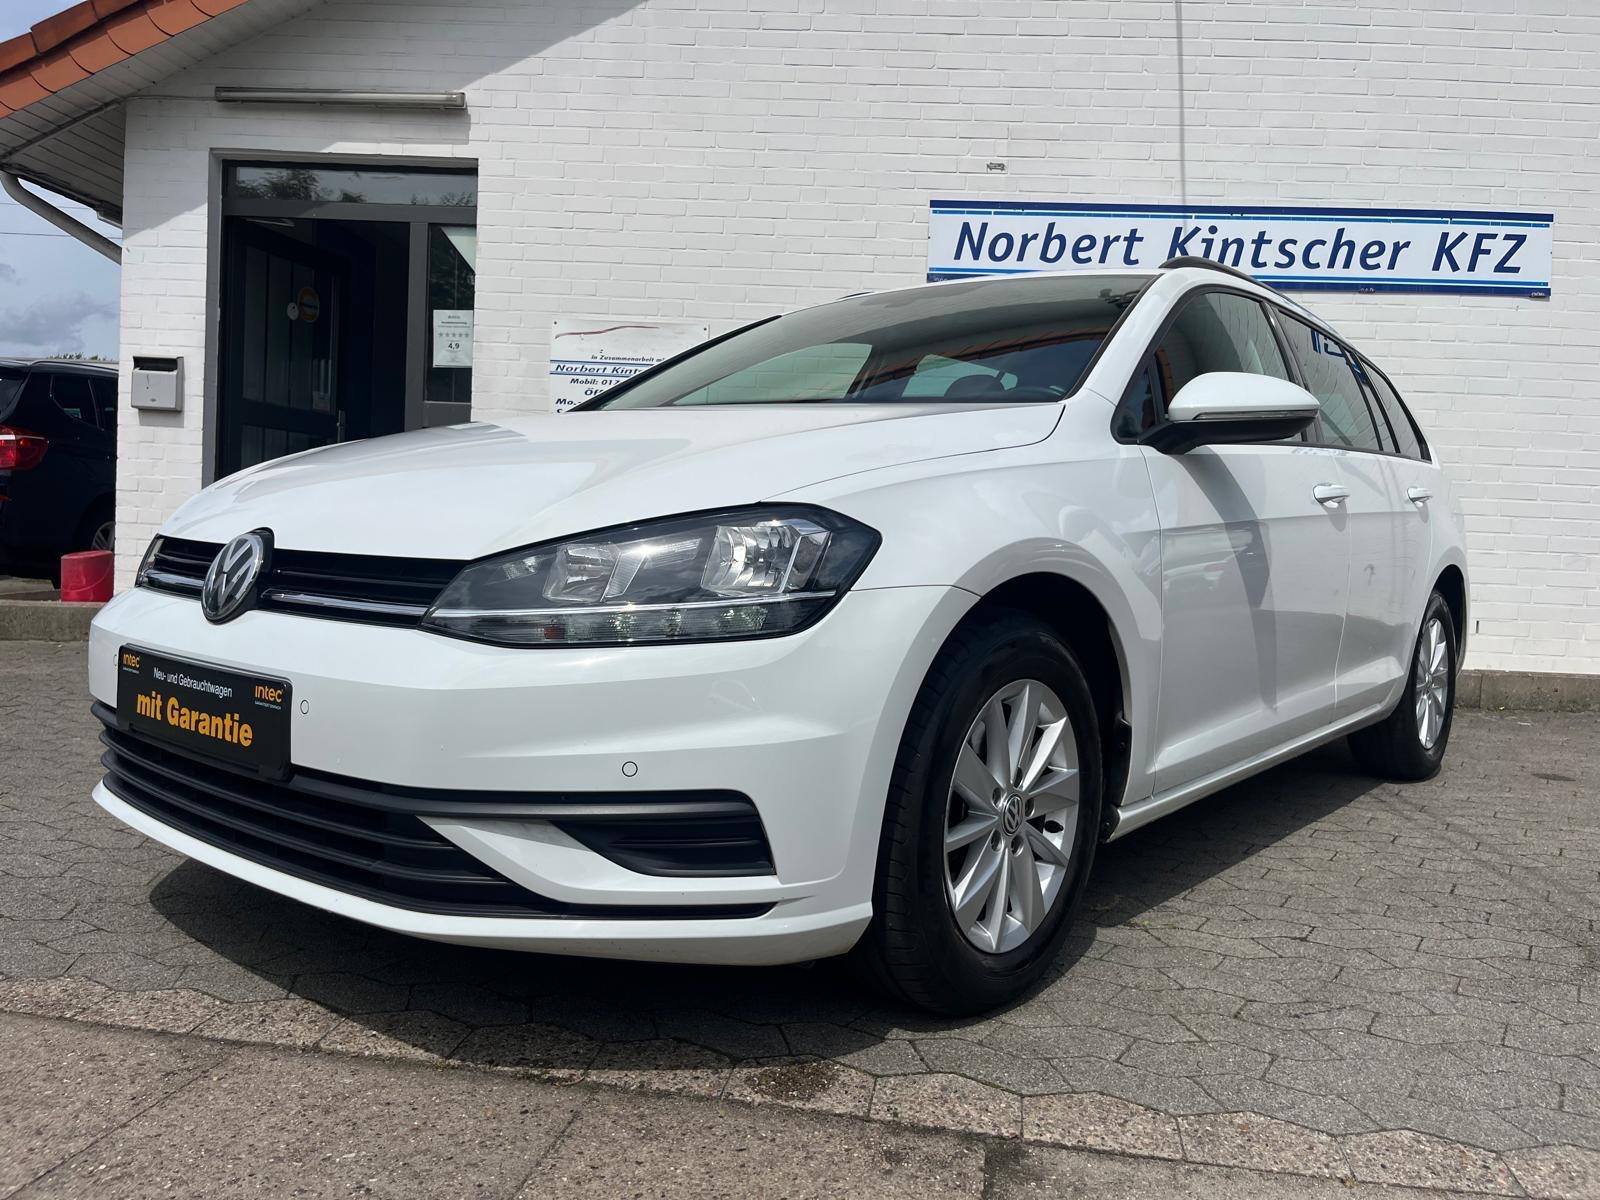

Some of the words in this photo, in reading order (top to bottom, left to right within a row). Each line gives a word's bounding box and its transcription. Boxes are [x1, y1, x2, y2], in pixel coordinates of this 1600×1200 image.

[953, 221, 1144, 266] Norbert
[1166, 224, 1412, 271] Kintscher
[1431, 231, 1528, 274] KFZ
[599, 354, 655, 363] Zusammenarbeit
[555, 364, 608, 373] Norbert
[611, 366, 642, 375] Kint
[569, 378, 598, 386] Mobil:
[122, 653, 140, 668] intec
[153, 667, 167, 681] Neu-
[167, 673, 178, 684] und
[178, 673, 233, 699] Gebrauchtwagen
[255, 685, 284, 703] intec
[136, 690, 163, 721] mit
[166, 696, 253, 747] Garantie
